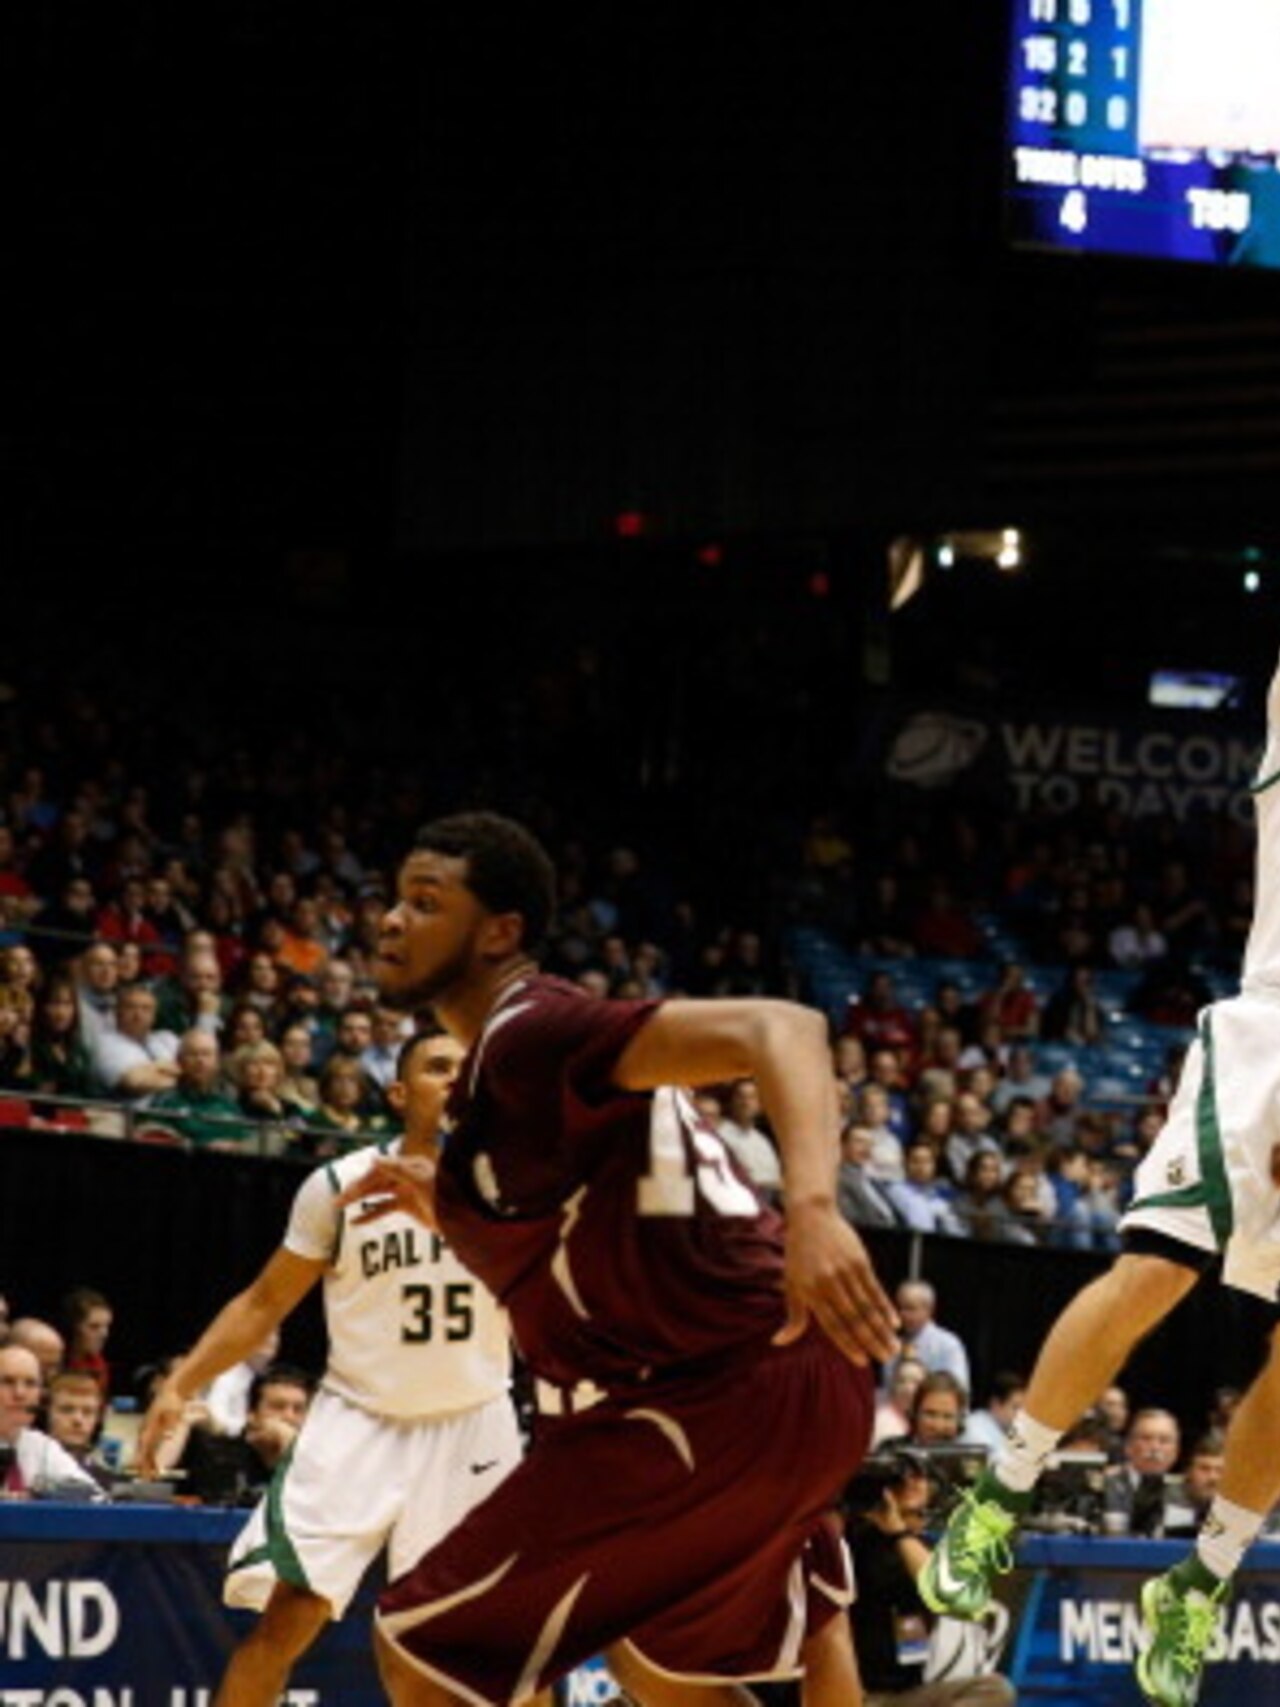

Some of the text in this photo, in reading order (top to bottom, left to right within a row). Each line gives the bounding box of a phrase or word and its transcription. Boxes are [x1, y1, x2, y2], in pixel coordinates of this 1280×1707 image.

[1067, 41, 1087, 76] 2
[1112, 46, 1127, 79] 1
[1060, 190, 1087, 233] 4
[360, 1227, 422, 1281] CAL
[401, 1282, 475, 1345] 35
[0, 1579, 120, 1660] ND
